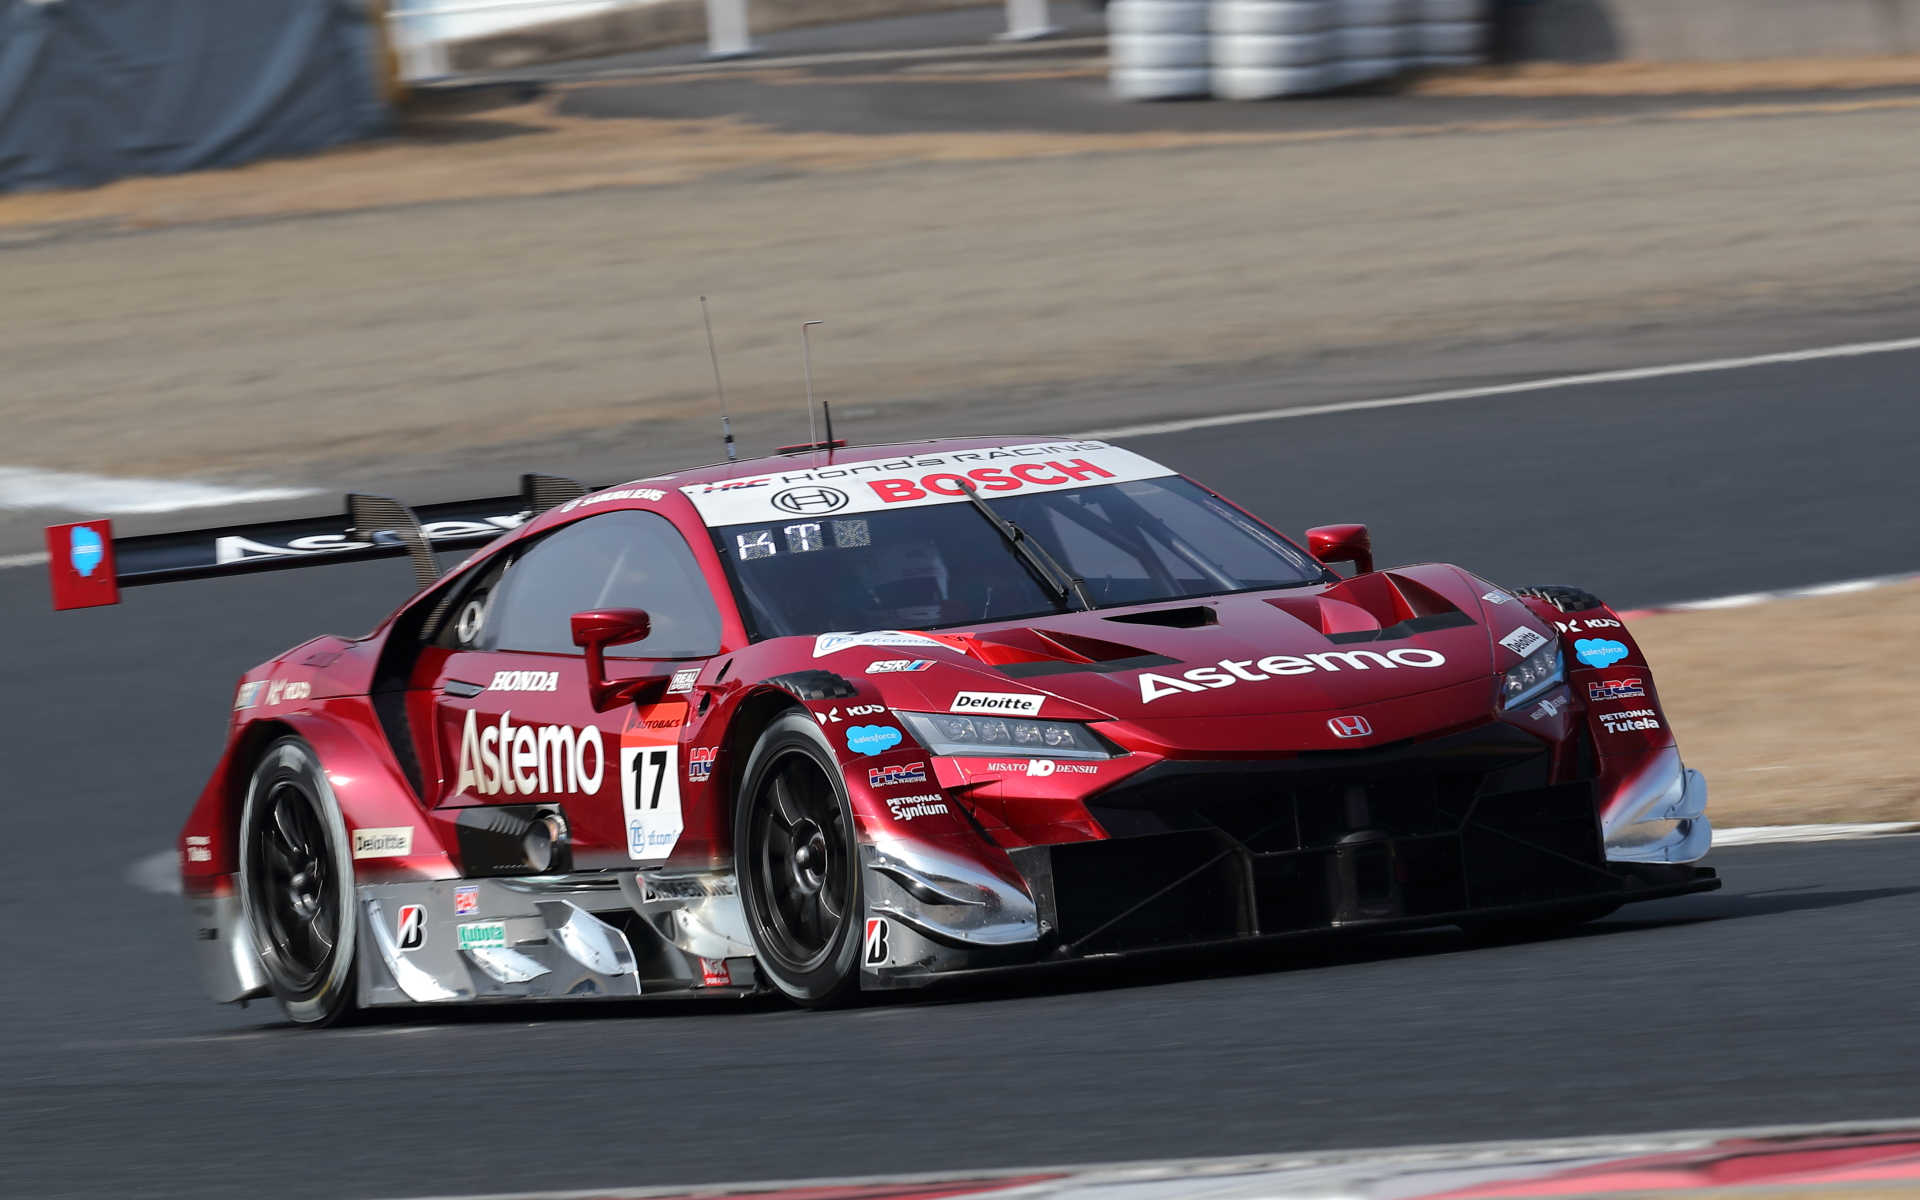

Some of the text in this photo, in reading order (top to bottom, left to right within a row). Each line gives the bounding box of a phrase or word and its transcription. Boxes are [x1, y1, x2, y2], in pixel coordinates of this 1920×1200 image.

[782, 456, 946, 484] Honda
[952, 440, 1104, 464] RACING
[866, 458, 1118, 504] BOSCH
[1581, 646, 1624, 656] salesforce
[487, 670, 560, 692] HONDA
[674, 672, 697, 683] REAL
[1137, 647, 1447, 705] Astemo
[1588, 678, 1644, 699] HRC
[635, 719, 681, 729] AUTOBACS
[1598, 708, 1656, 722] PETRONAS
[1603, 717, 1660, 734] Tutela
[853, 732, 897, 744] salesforce
[454, 708, 605, 798] Astemo
[868, 761, 926, 785] HRC
[986, 762, 1027, 772] MISATO
[1056, 764, 1099, 774] DENSHI
[631, 750, 668, 810] 17
[886, 794, 943, 807] PETRONAS
[891, 803, 949, 821] Syntium
